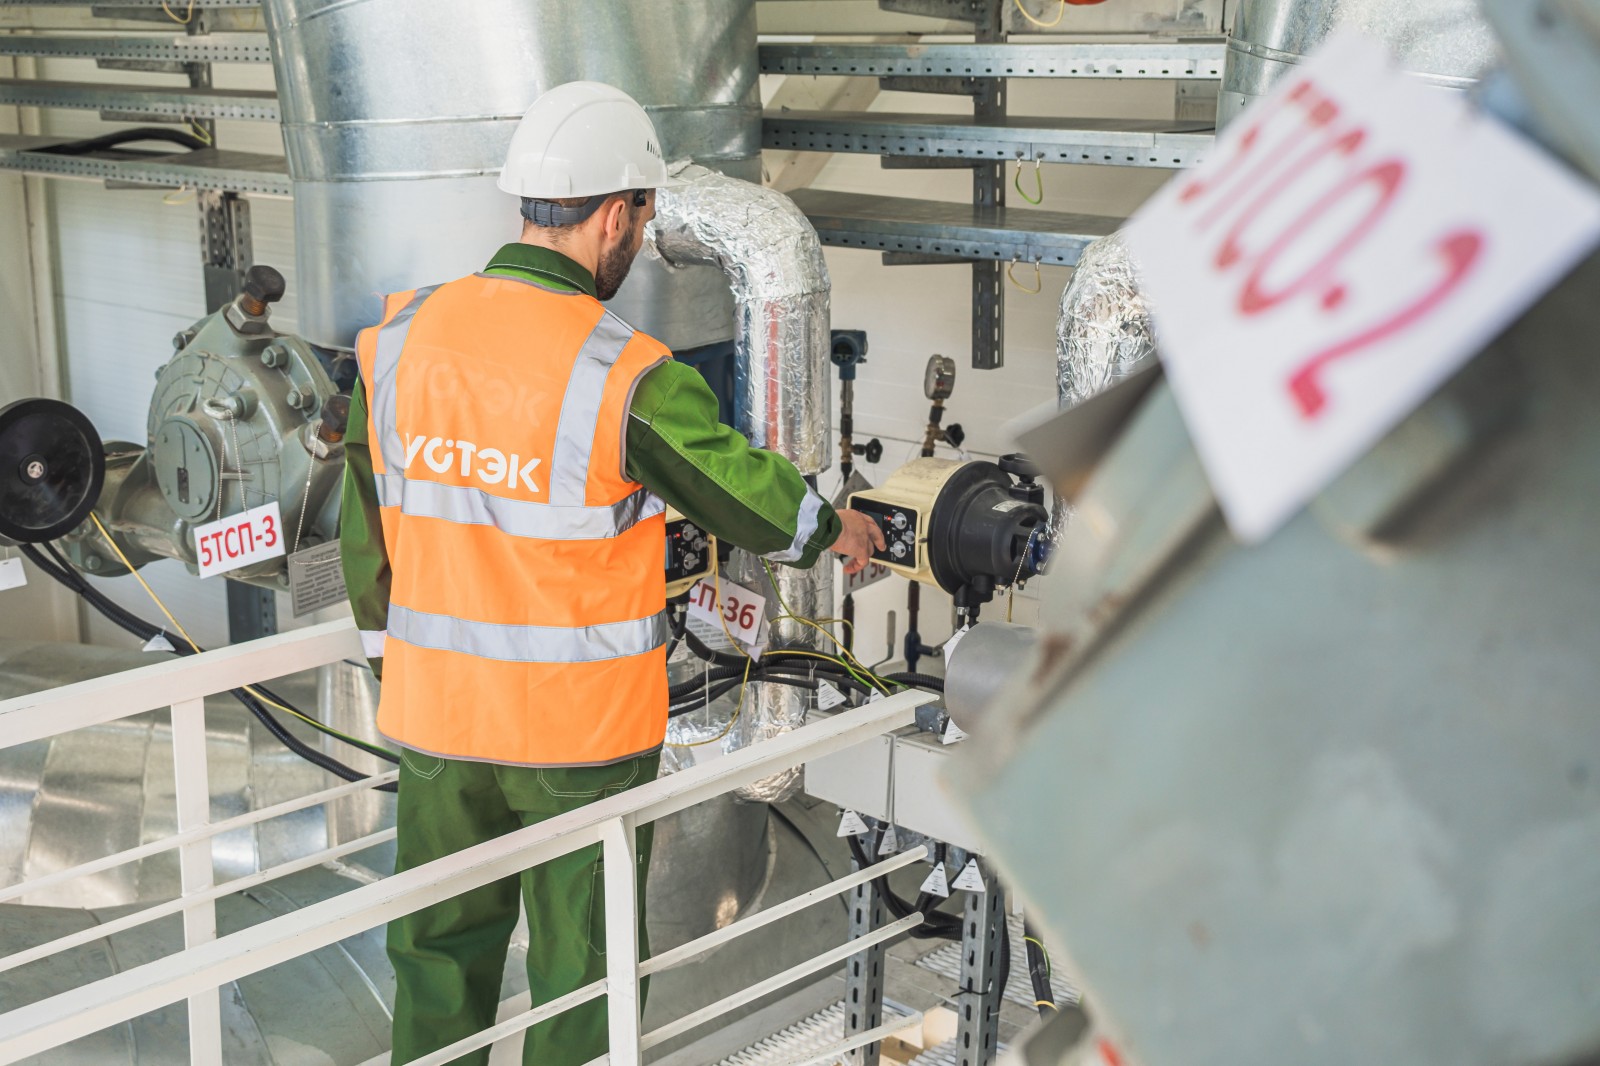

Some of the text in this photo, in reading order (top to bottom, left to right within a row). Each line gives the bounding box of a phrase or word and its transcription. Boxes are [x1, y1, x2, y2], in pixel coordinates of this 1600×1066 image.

[404, 432, 542, 493] УСТЭК
[200, 515, 278, 567] 5ТСП-3
[690, 582, 757, 630] П-36
